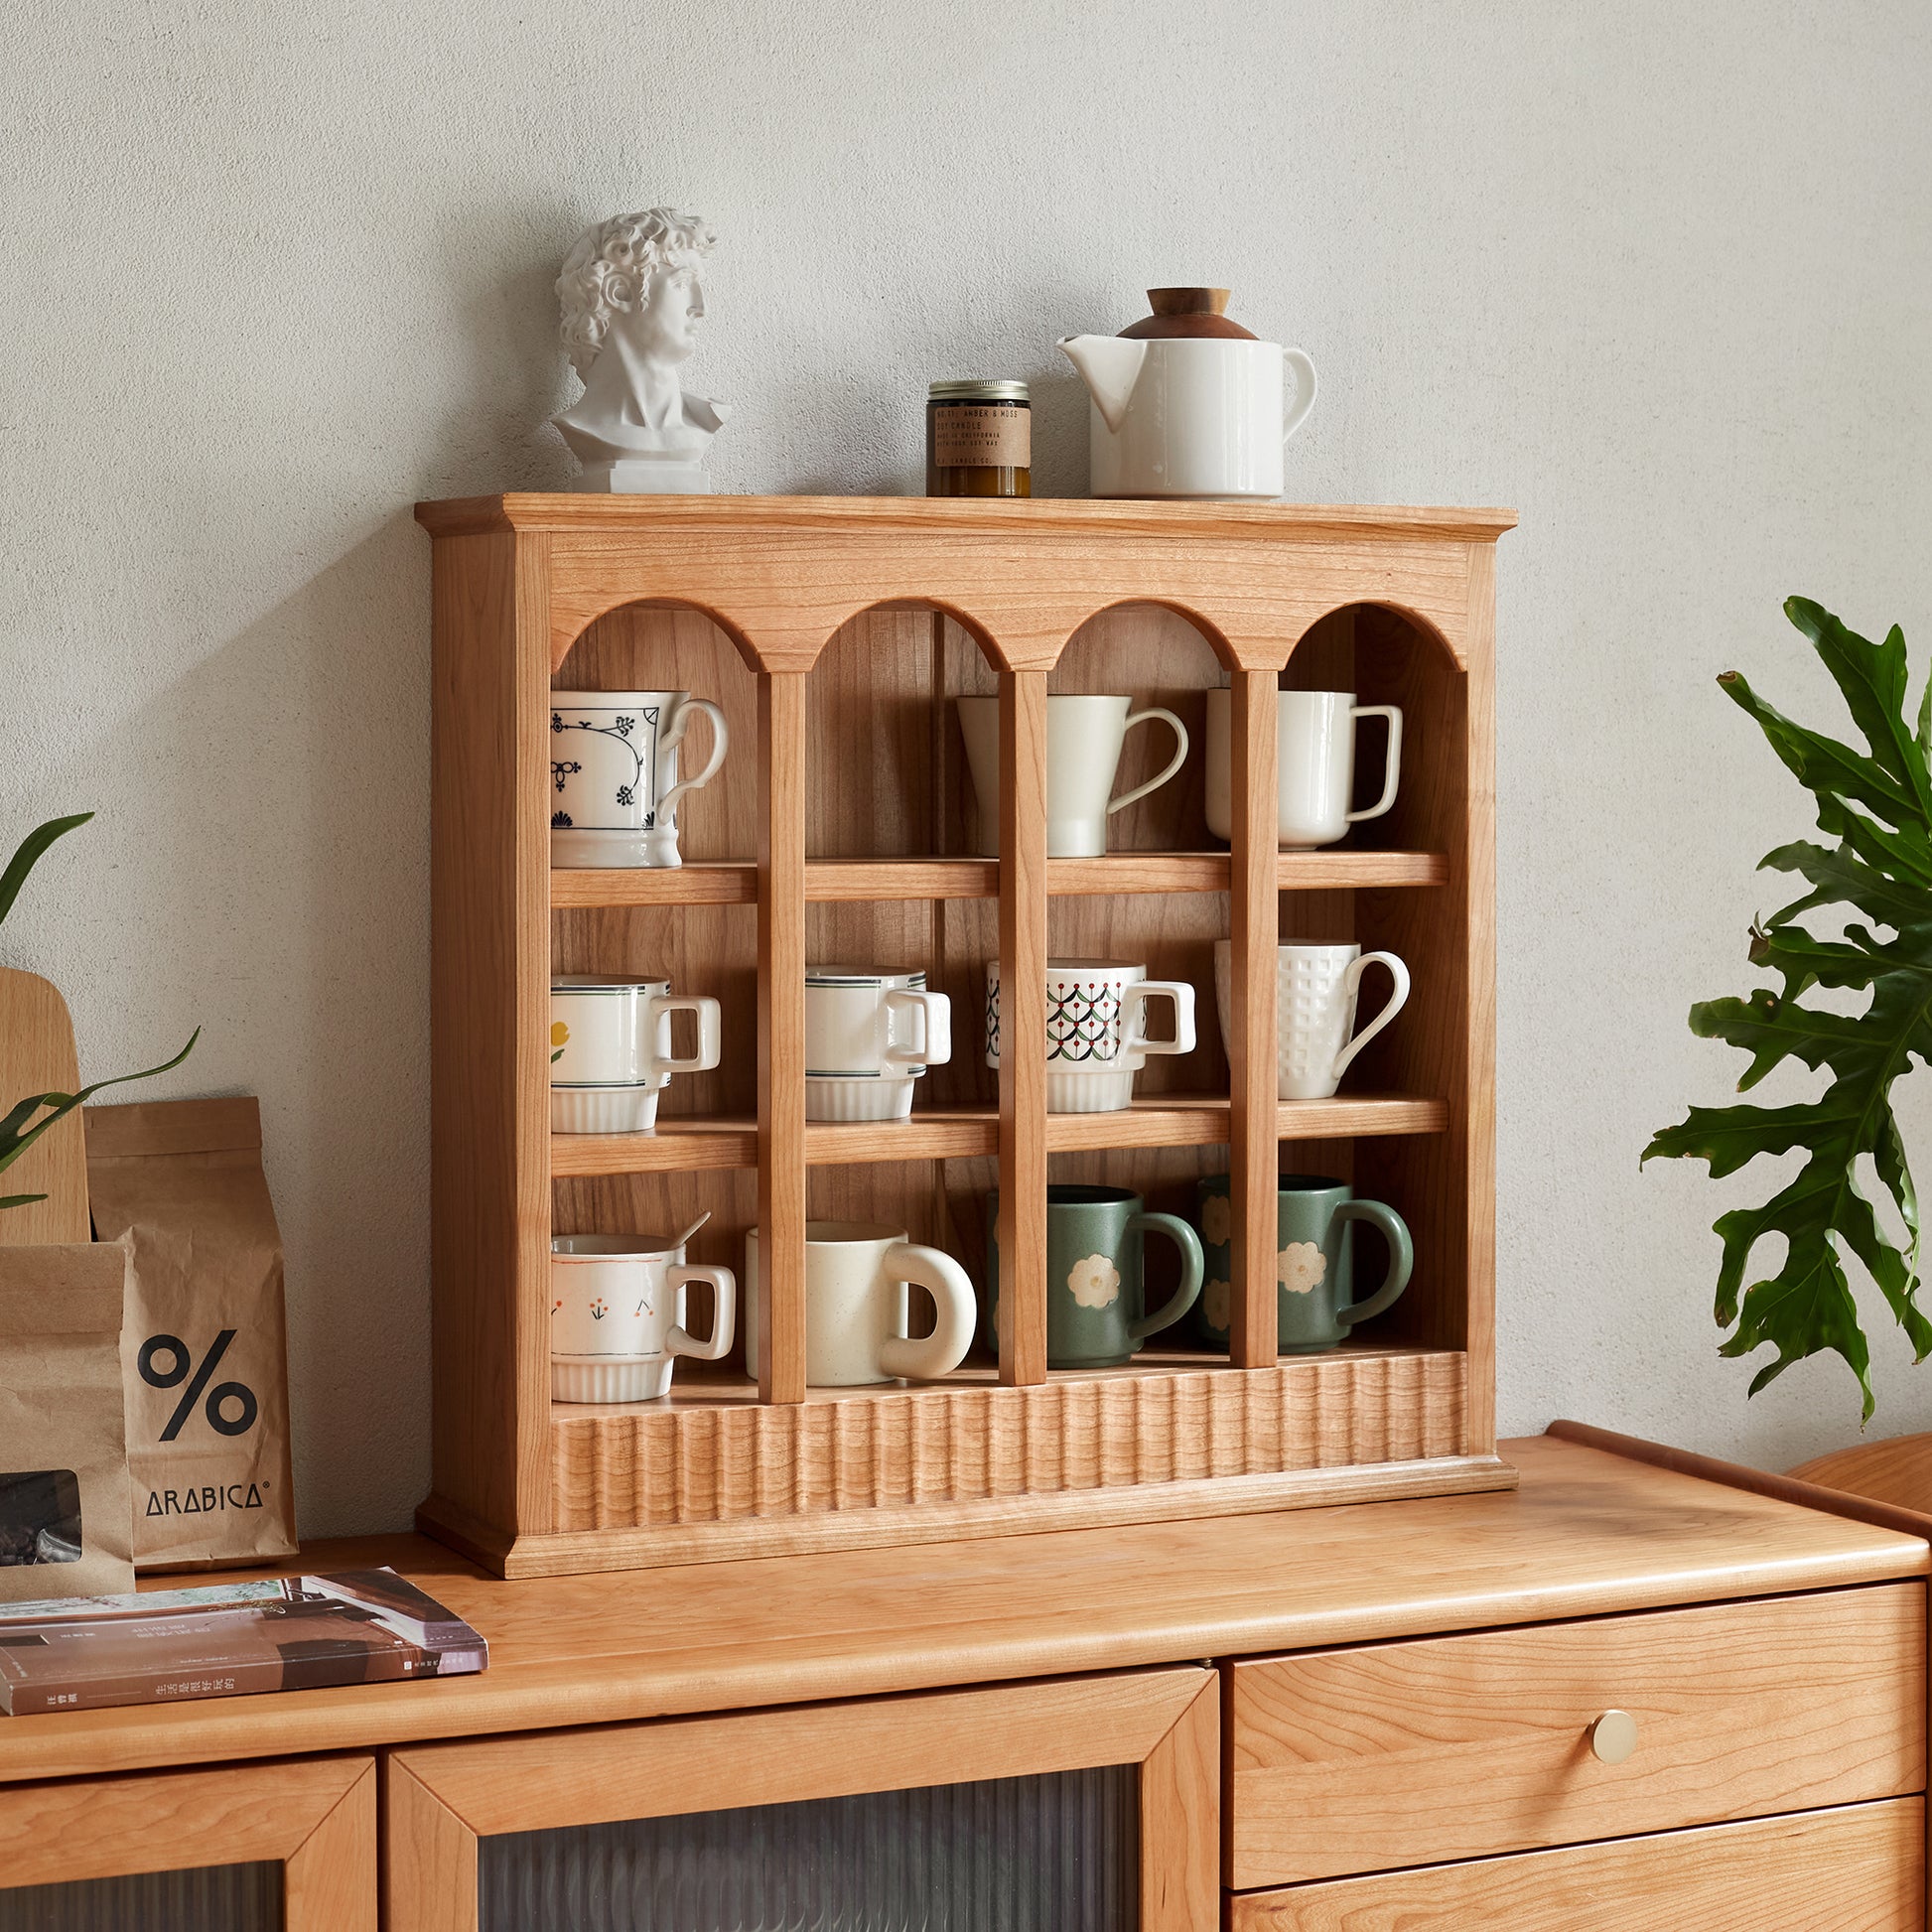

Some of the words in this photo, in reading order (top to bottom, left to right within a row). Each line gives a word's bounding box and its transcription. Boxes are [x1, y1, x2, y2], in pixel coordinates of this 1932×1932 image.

[155, 1678, 235, 1696] 生活是很好玩的
